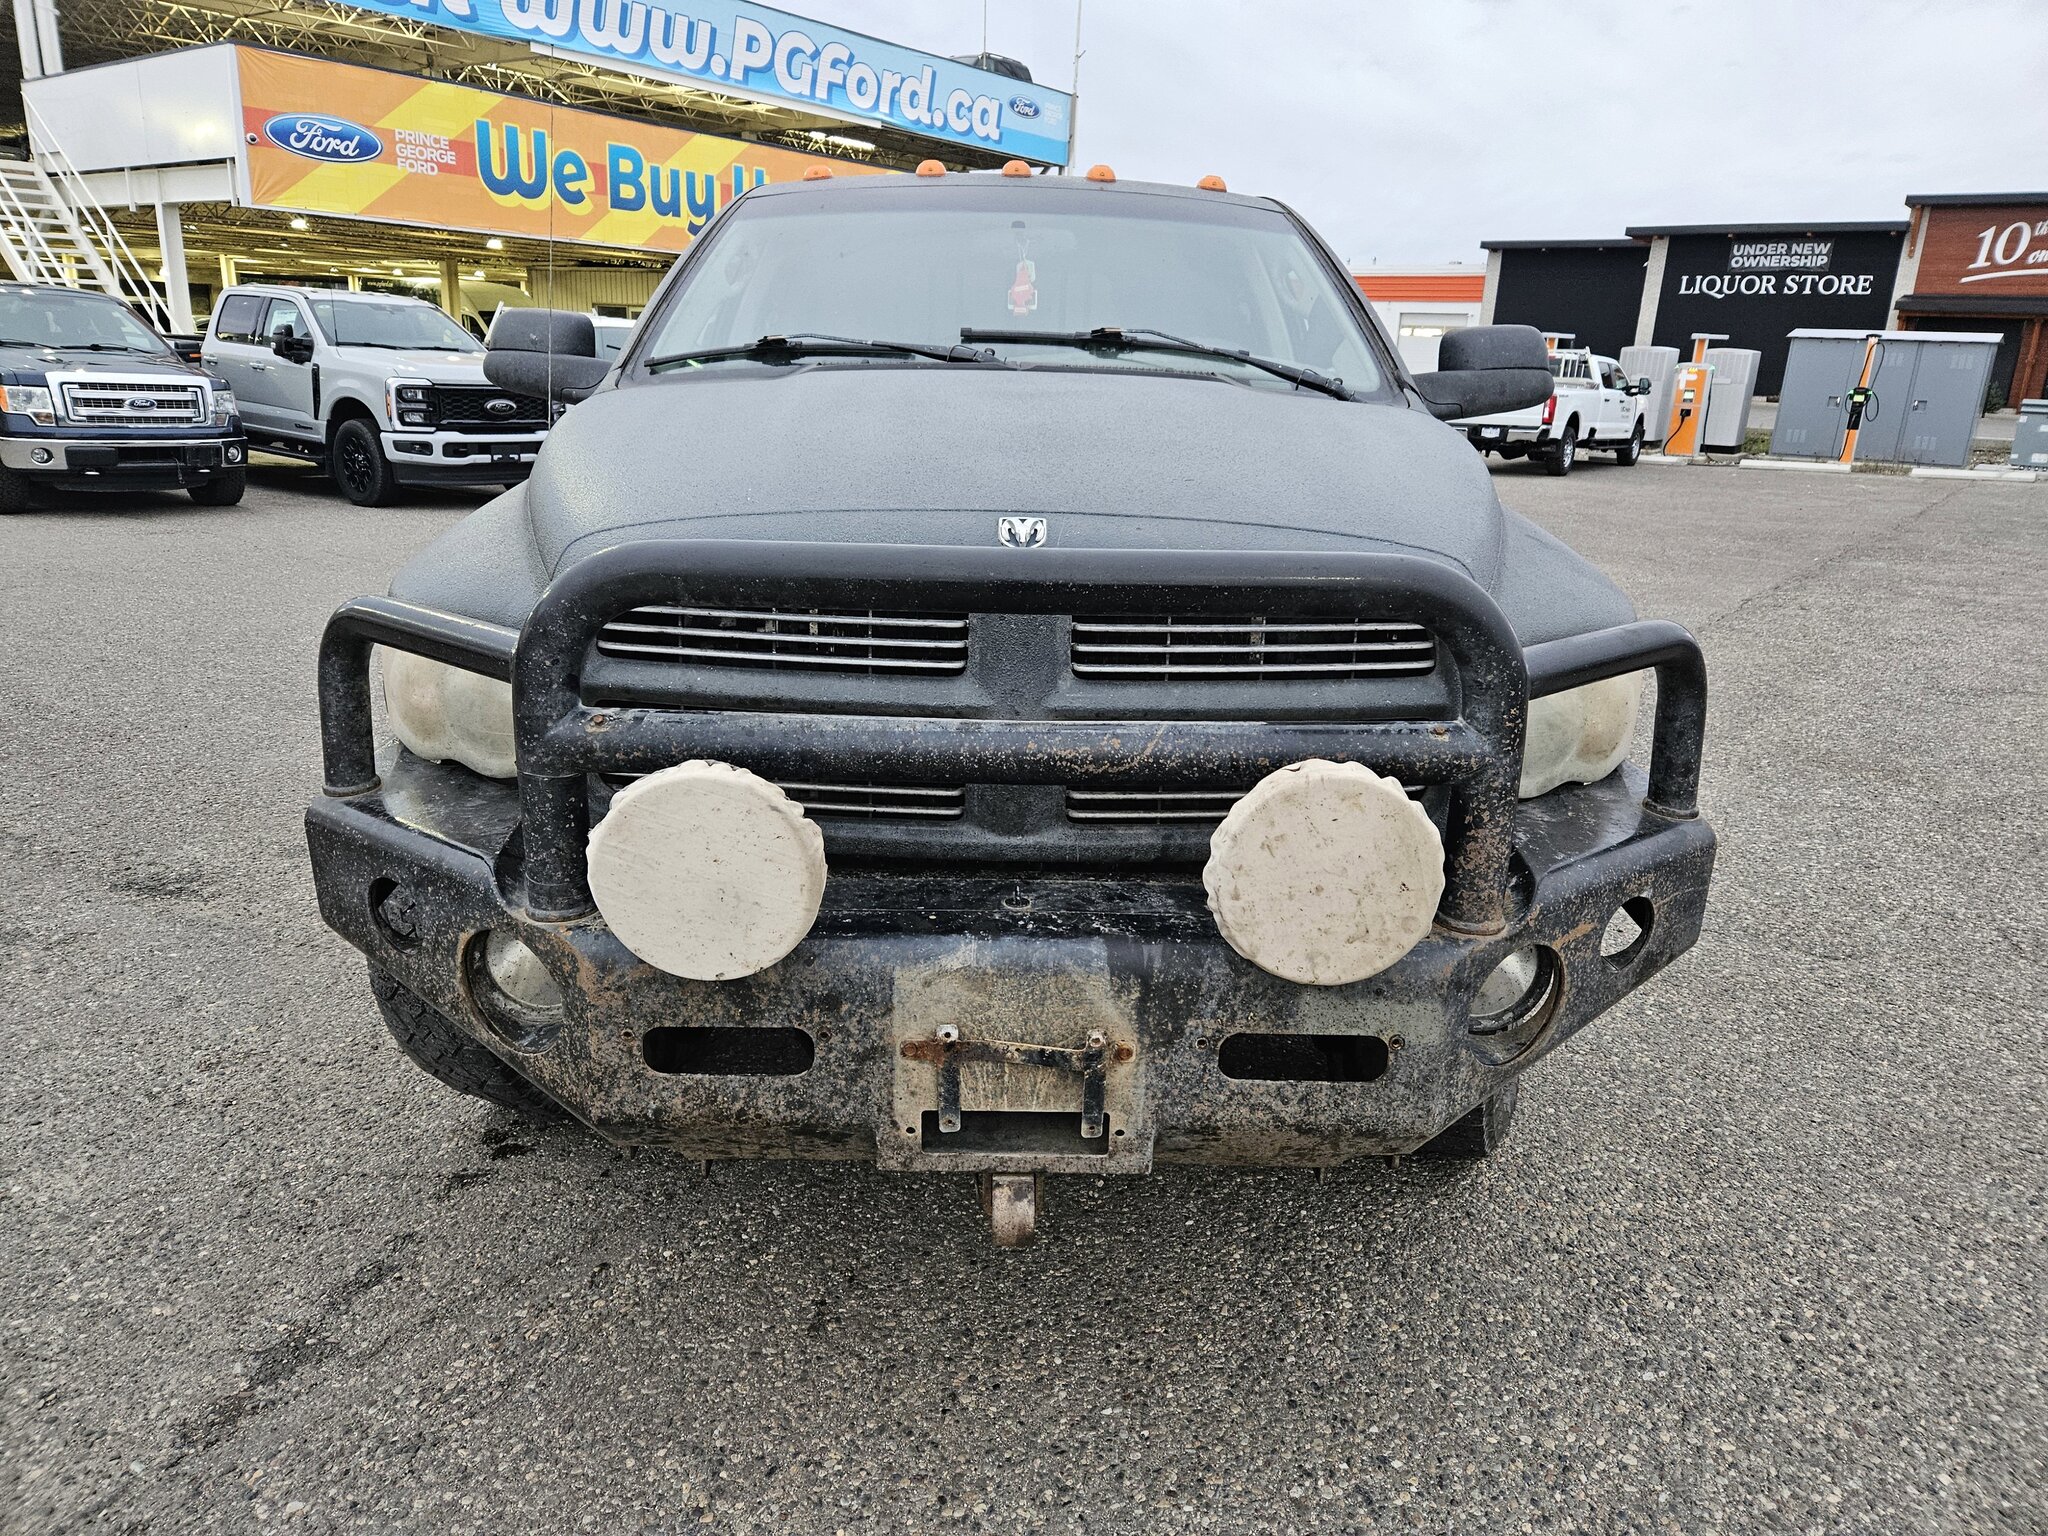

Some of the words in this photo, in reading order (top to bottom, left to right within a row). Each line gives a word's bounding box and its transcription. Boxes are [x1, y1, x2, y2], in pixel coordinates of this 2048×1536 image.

[1013, 97, 1036, 116] Ford
[289, 118, 361, 157] Ford
[394, 128, 450, 150] PRINCE
[395, 144, 457, 165] GEORGE
[397, 158, 439, 176] FORD
[475, 118, 589, 205] We
[607, 141, 715, 236] Buy
[1733, 243, 1788, 256] UNDER
[1791, 242, 1831, 255] NEW
[1730, 255, 1829, 268] OWNERSHIP
[1678, 274, 1777, 299] LIQUOR
[1783, 274, 1874, 295] STORE
